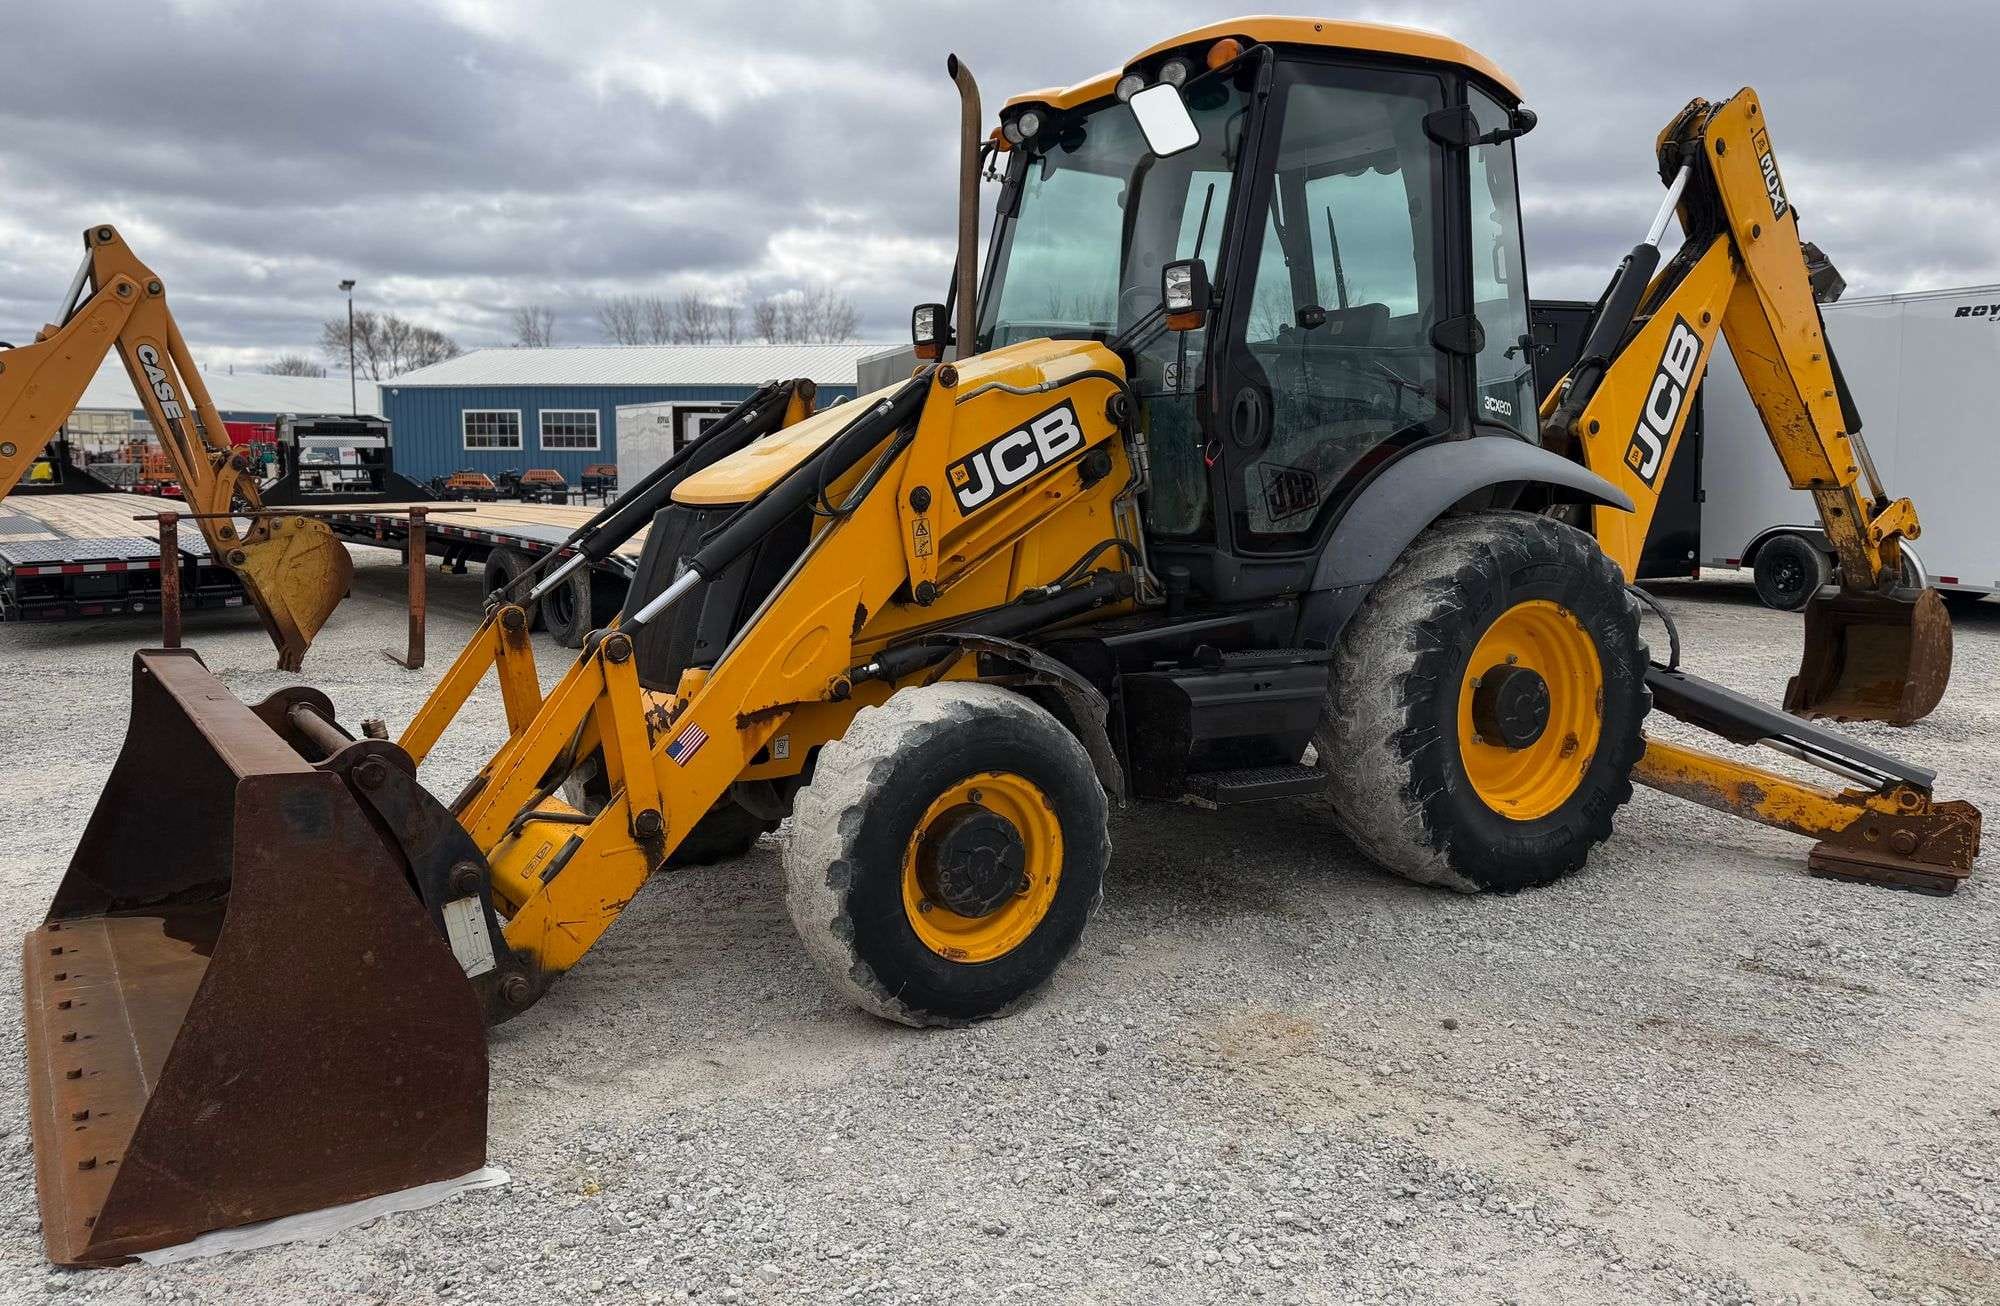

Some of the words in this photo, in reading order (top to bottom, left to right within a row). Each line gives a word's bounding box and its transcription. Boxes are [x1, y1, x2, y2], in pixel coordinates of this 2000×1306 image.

[138, 344, 185, 419] CASE
[1637, 324, 1699, 479] JCB
[959, 407, 1081, 508] JCB
[1268, 470, 1317, 515] JCB
